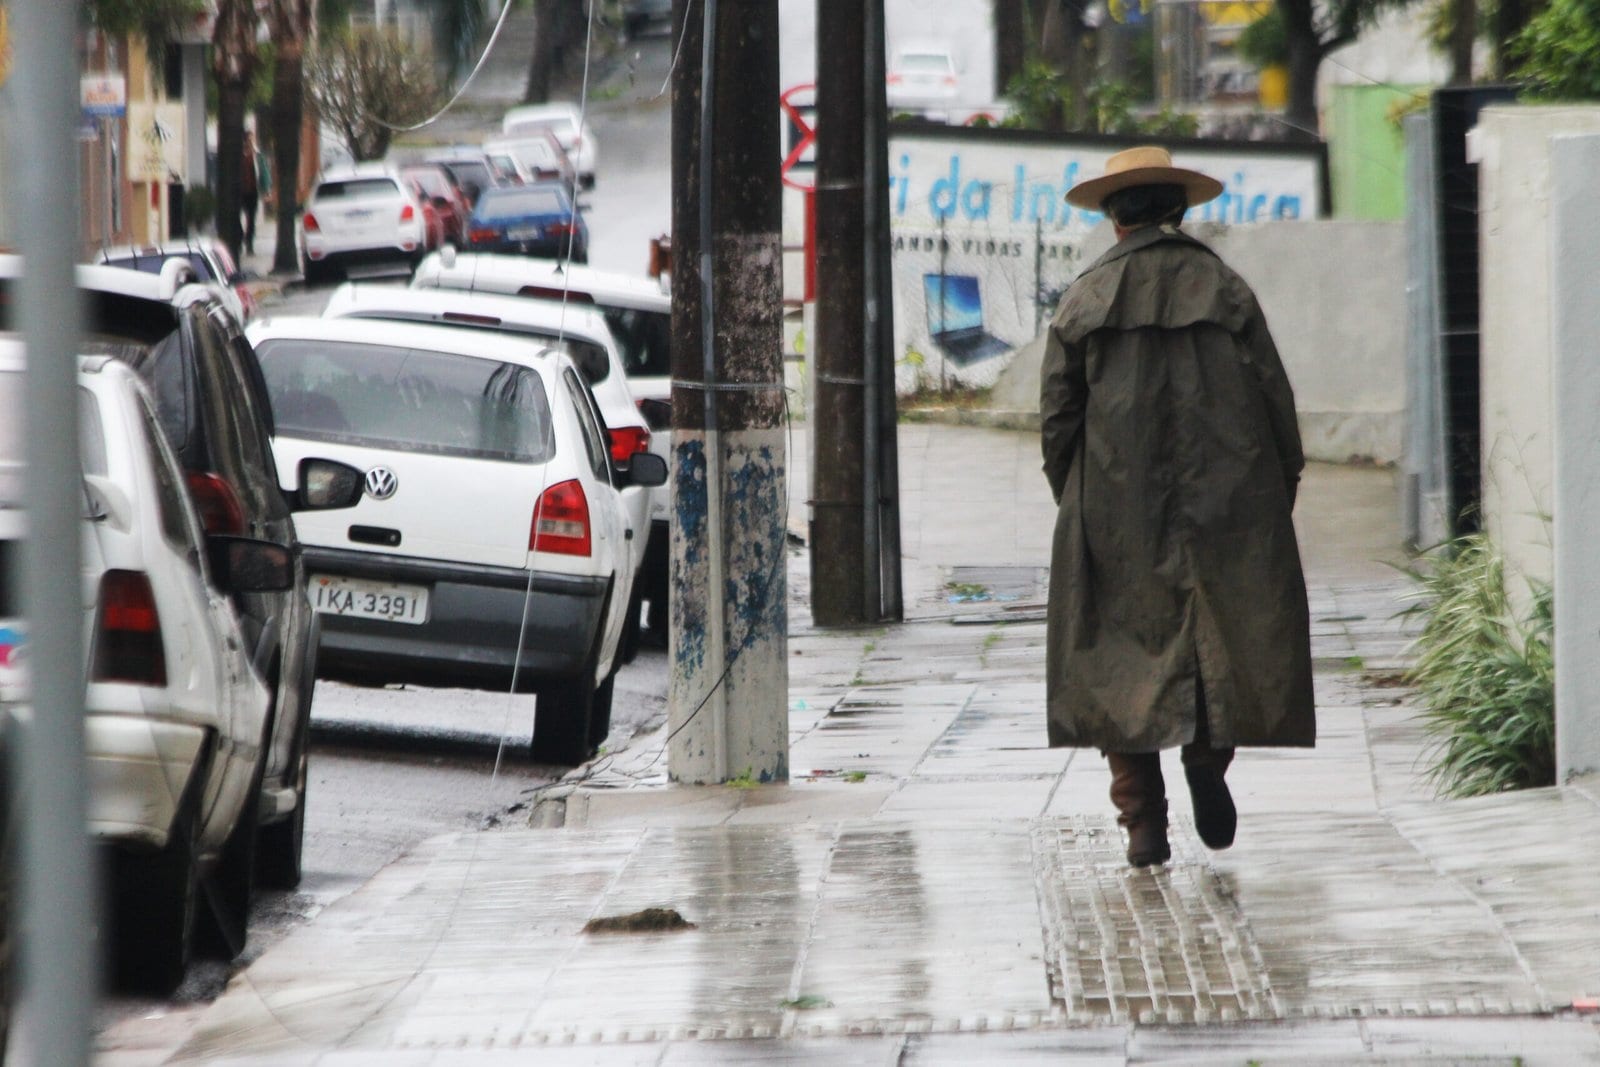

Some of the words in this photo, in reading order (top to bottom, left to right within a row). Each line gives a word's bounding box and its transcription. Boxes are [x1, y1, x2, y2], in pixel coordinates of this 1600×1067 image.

[929, 154, 993, 222] da
[1011, 161, 1300, 226] Inftica
[962, 239, 1022, 258] VIDAS
